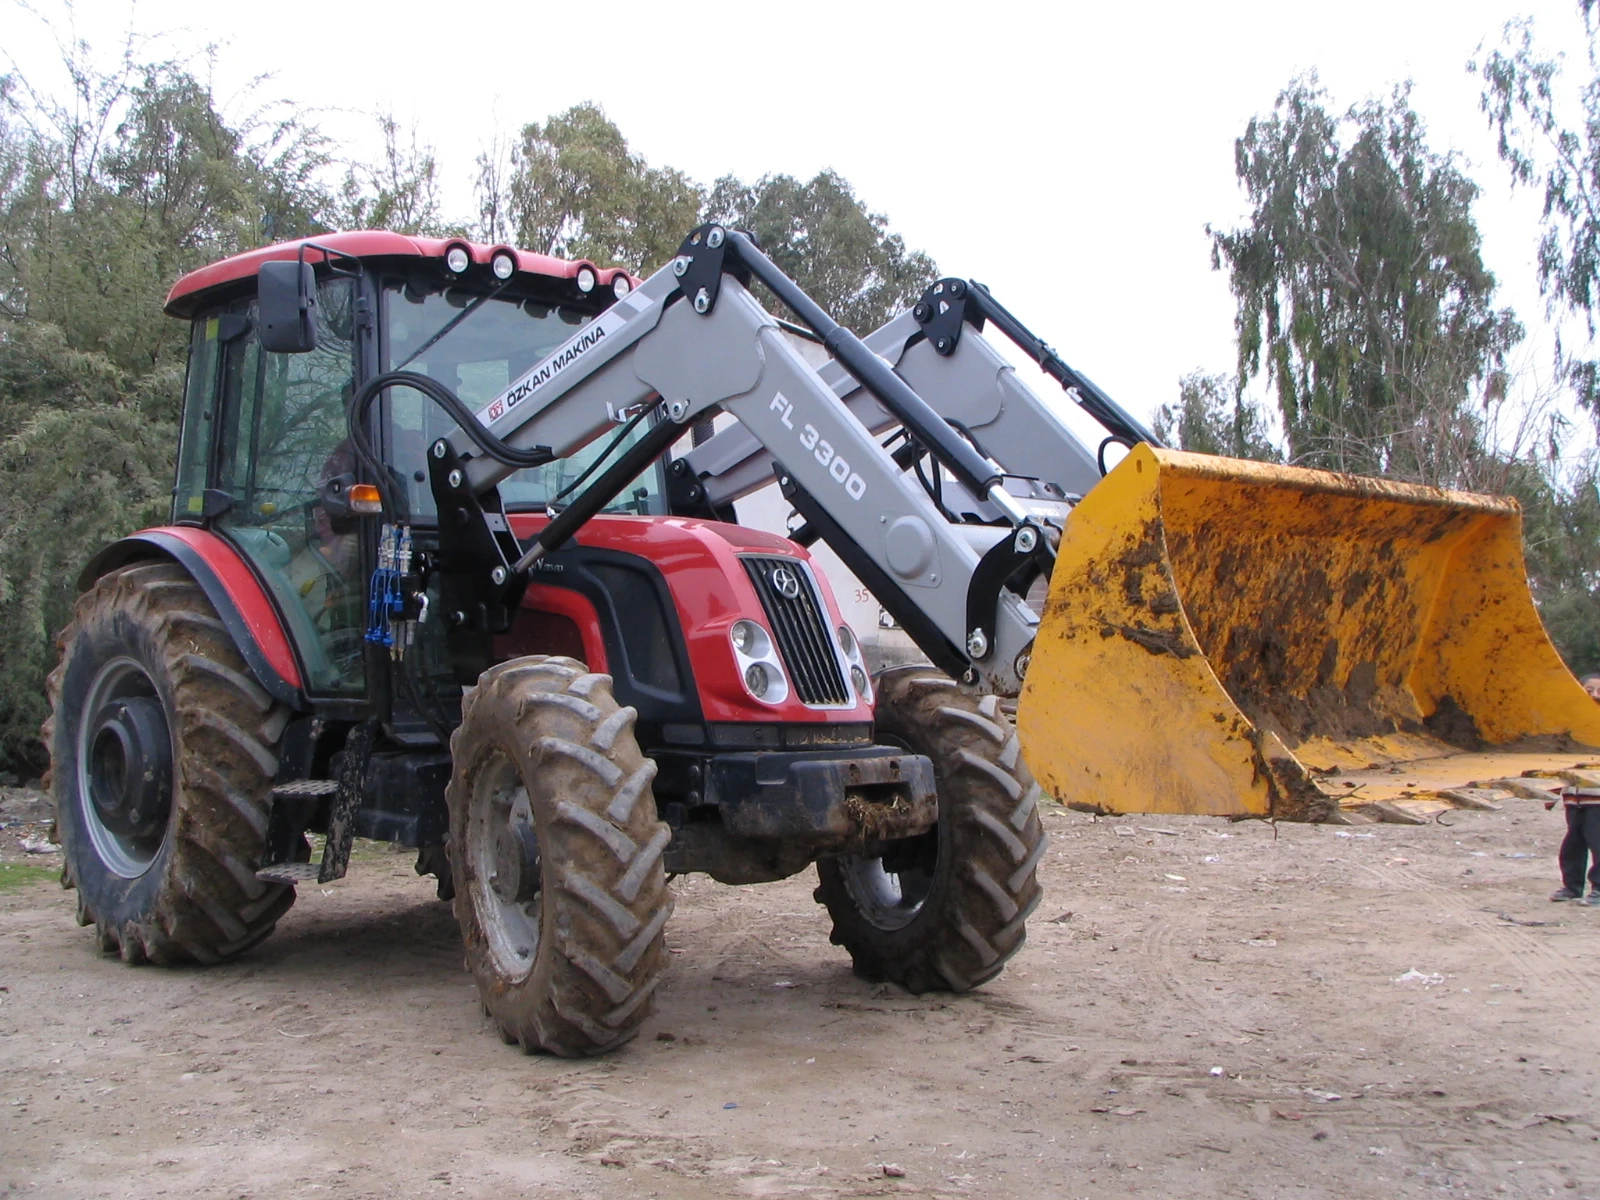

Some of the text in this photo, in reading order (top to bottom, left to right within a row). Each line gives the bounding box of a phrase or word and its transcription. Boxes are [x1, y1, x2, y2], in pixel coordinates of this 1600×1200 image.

[507, 326, 606, 408] ÖZKAN MAKİNA
[769, 391, 867, 501] FL 3300
[854, 588, 870, 603] 35
